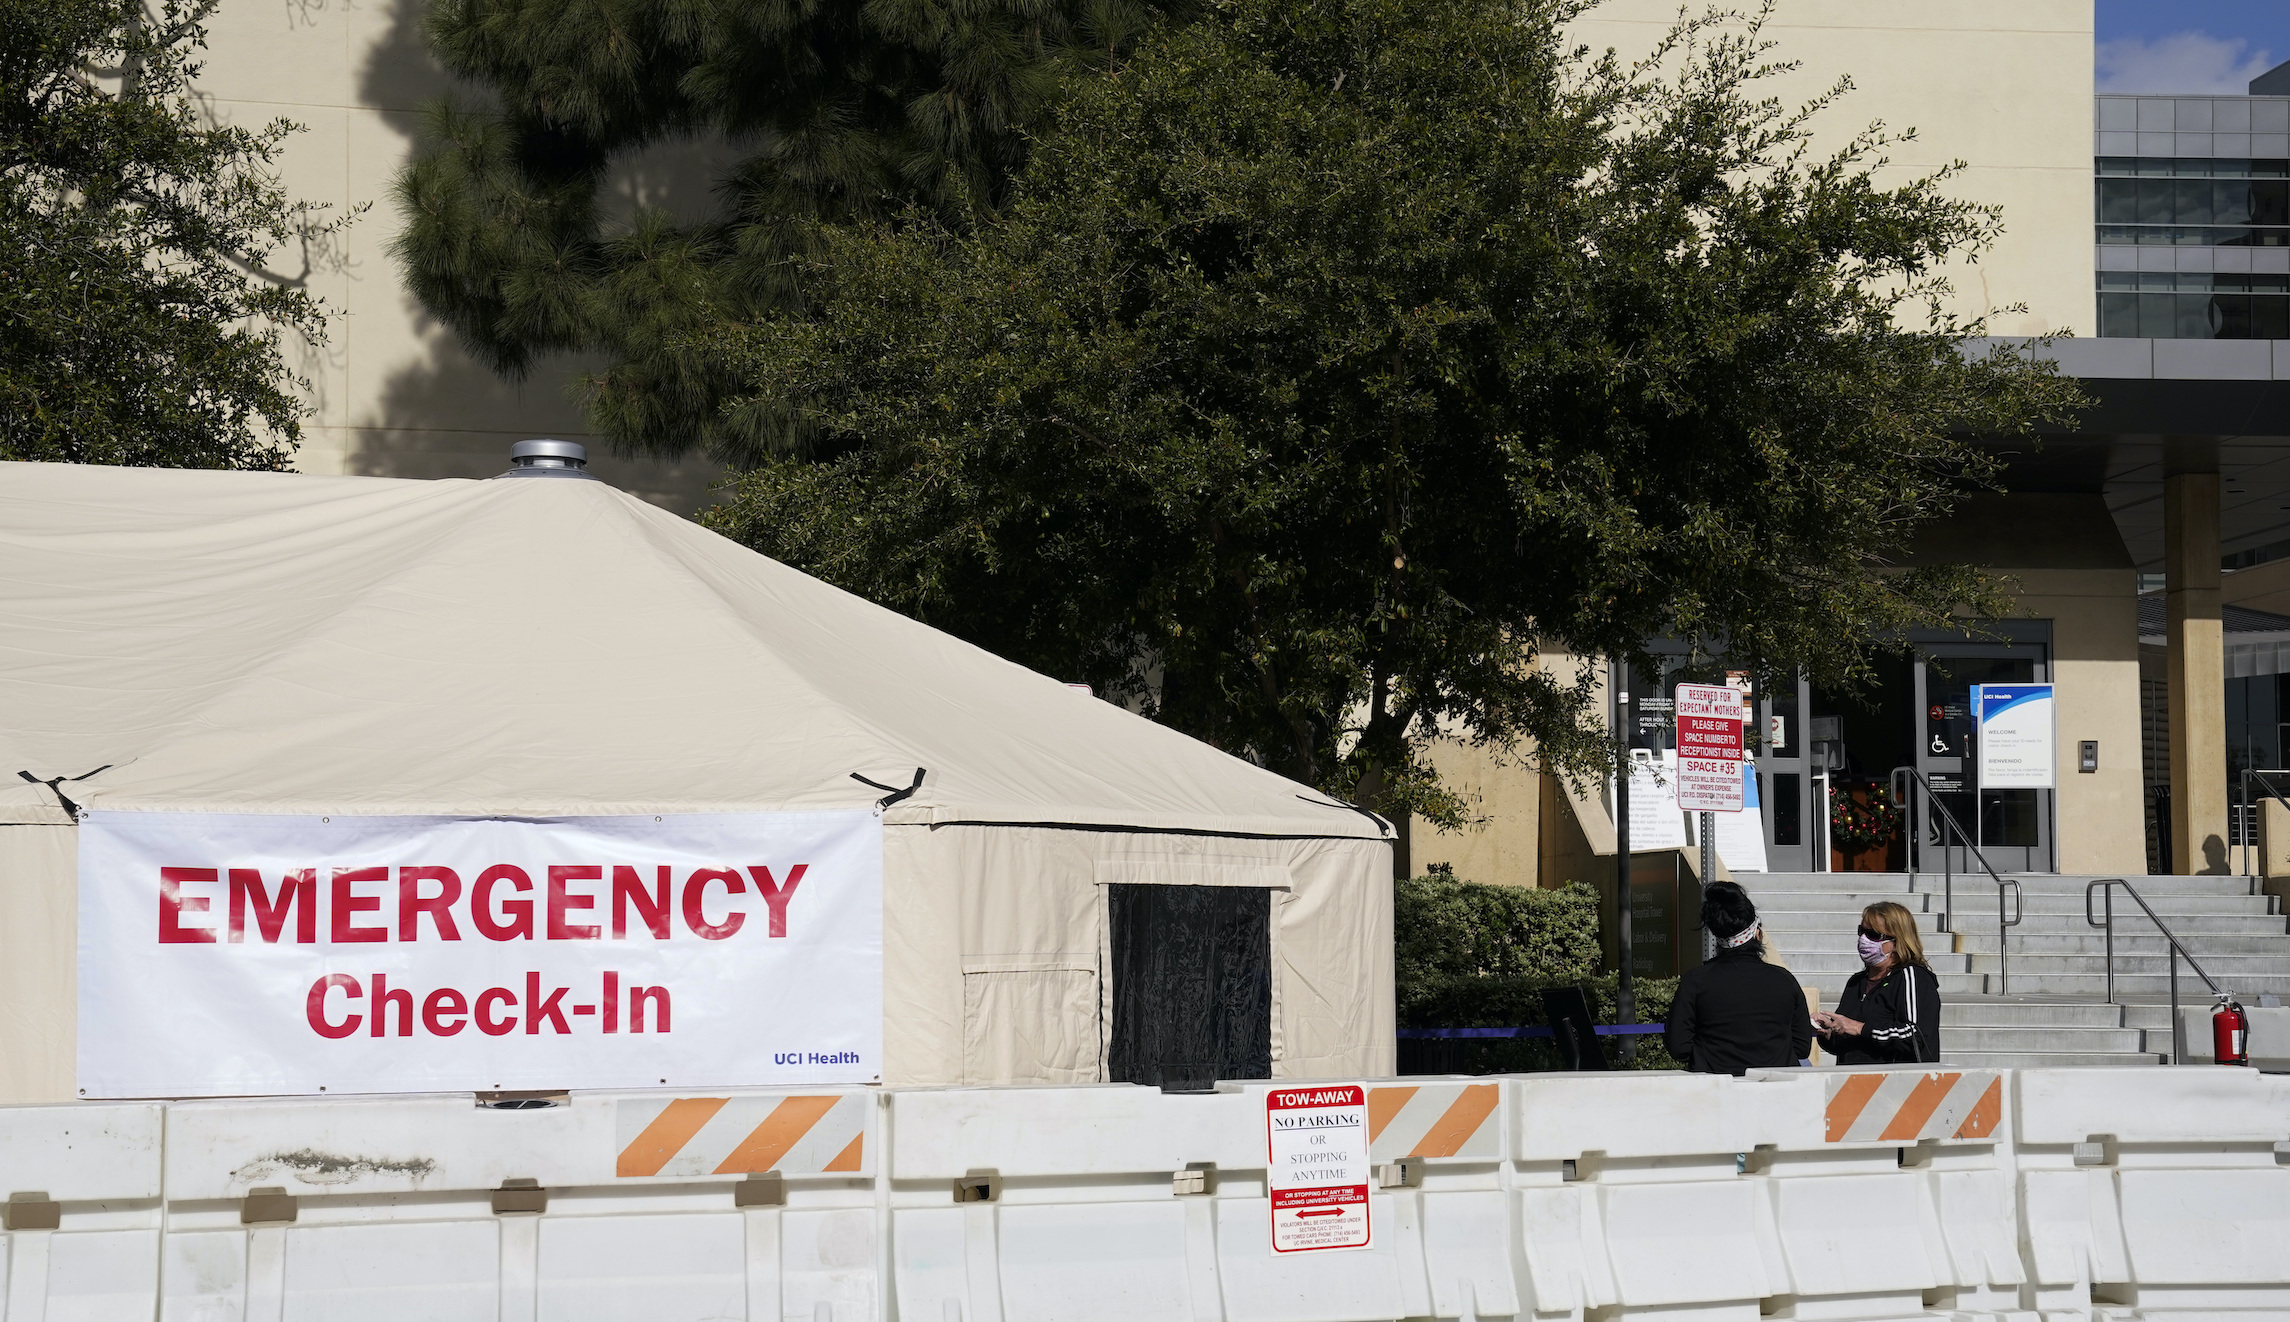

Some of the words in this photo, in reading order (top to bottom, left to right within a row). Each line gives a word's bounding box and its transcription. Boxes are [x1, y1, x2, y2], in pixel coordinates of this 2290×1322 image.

[1689, 690, 1718, 701] RESERVED
[1721, 692, 1731, 702] FOR
[1680, 703, 1712, 714] EXPECTANT
[1715, 705, 1740, 716] MOTHERS
[1692, 720, 1714, 730] PLEASE
[1715, 721, 1728, 731] GIVE
[1685, 733, 1703, 742] SPACE
[1704, 734, 1728, 744] NUMBER
[1728, 735, 1736, 744] TO
[1681, 746, 1721, 757] RECEPTIONIST
[1722, 748, 1740, 758] INSIDE
[1687, 761, 1717, 772] SPACE
[1720, 762, 1735, 774] #35
[158, 864, 808, 944] EMERGENCY
[1633, 932, 1644, 943] Labor
[1650, 931, 1667, 945] Delivery
[306, 970, 672, 1039] Check-In
[775, 1053, 802, 1065] UCI
[808, 1052, 859, 1064] Health
[1277, 1090, 1354, 1106] TOW-AWAY
[1275, 1117, 1294, 1128] NO
[1299, 1114, 1359, 1127] PARKING
[1310, 1135, 1326, 1145] OR
[1291, 1152, 1347, 1164] STOPPING
[1292, 1169, 1347, 1181] ANYTIME
